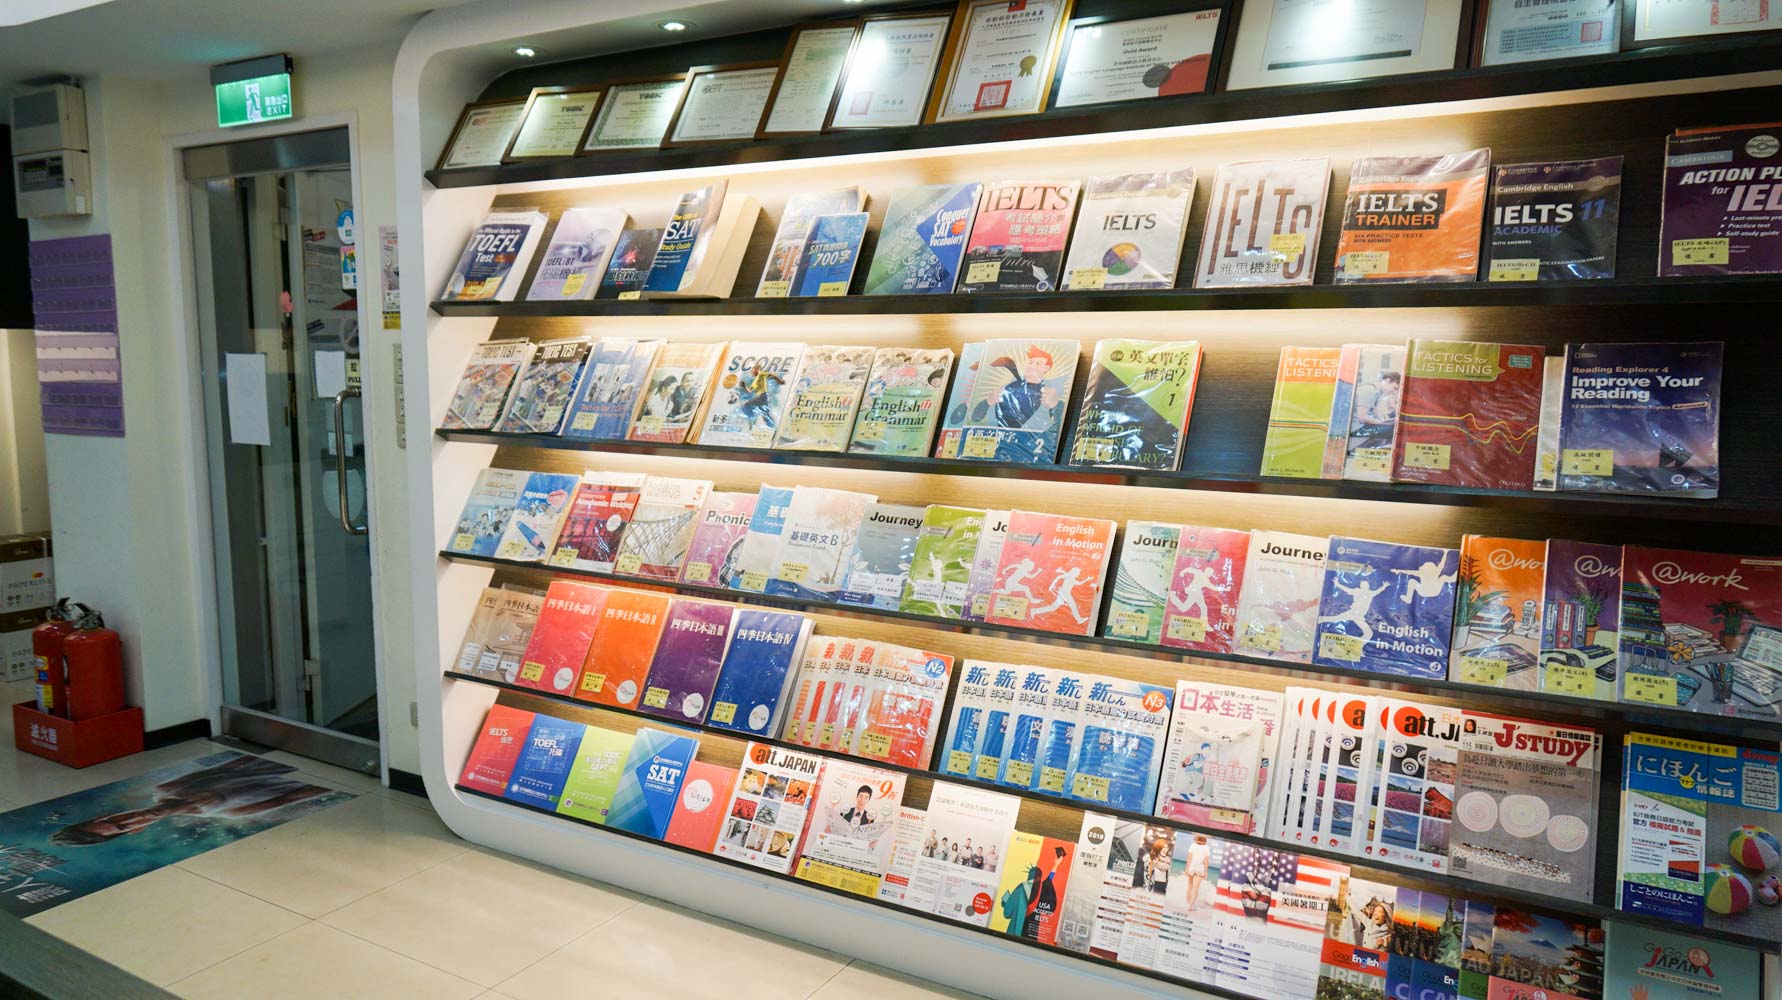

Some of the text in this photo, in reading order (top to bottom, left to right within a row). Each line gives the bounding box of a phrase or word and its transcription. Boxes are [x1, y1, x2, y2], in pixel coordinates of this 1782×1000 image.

[1195, 12, 1218, 20] IELTS
[266, 104, 287, 116] EXIT
[1671, 154, 1725, 164] CAMBRIDGE
[1678, 166, 1782, 186] ACTION PL
[1496, 182, 1574, 194] Cambridge English
[983, 185, 1074, 213] IELTS
[1356, 193, 1438, 212] IELTS
[1711, 184, 1782, 211] for IEL
[936, 208, 970, 223] Conquer
[1355, 214, 1436, 226] TRAINER
[1493, 200, 1606, 225] IELTS 11
[665, 218, 701, 240] SAT
[933, 222, 951, 237] SAT
[1103, 213, 1157, 231] IELTS
[1493, 225, 1563, 237] ACADEMIC
[469, 234, 520, 252] TOEFL
[660, 242, 692, 252] Study Guide
[929, 235, 964, 247] Vocabulary
[475, 252, 494, 263] Test
[812, 250, 851, 266] 700字
[1219, 262, 1280, 276] 雅思機經
[500, 345, 517, 358] TEST
[560, 344, 579, 358] TEST
[1128, 349, 1190, 366] 英文單字
[1413, 351, 1488, 365] TACTICS for
[728, 355, 795, 373] SCORE
[1288, 357, 1338, 368] TACTICS
[1413, 362, 1493, 376] LISTENING
[1143, 367, 1187, 388] 誰怕?
[1284, 367, 1338, 378] LISTENI
[1572, 366, 1613, 375] Reading
[1615, 366, 1660, 375] Explorer
[1571, 375, 1704, 390] Improve Your
[796, 395, 843, 408] English
[1167, 393, 1176, 406] 1
[1571, 387, 1651, 403] Reading
[871, 397, 921, 414] English
[789, 407, 849, 421] Grammar
[864, 411, 928, 426] Grammar
[1033, 438, 1045, 454] 2
[705, 510, 751, 526] Phonic
[869, 511, 924, 529] Journey
[1055, 523, 1096, 536] English
[1052, 537, 1104, 550] in Motion
[1133, 534, 1178, 549] Journ
[1487, 549, 1544, 570] @wo
[1652, 561, 1750, 591] @work
[1378, 621, 1429, 639] English
[1376, 637, 1444, 658] in Motion
[926, 662, 944, 675] N2
[1430, 661, 1441, 671] 4
[965, 665, 989, 687] 新し
[993, 667, 1016, 690] 新し
[1022, 671, 1049, 693] 新し
[1056, 676, 1082, 699] 新し
[1143, 694, 1164, 708] N3
[1179, 688, 1254, 721] 日本生活
[1737, 707, 1777, 718] Richmond
[489, 727, 509, 737] IELTS
[1403, 714, 1461, 742] att.J
[533, 738, 558, 749] TOEFL
[1493, 722, 1592, 767] J'STUDY
[755, 748, 818, 775] att.JAPAN
[647, 764, 681, 786] SAT
[1636, 753, 1737, 787] にほんご
[900, 812, 920, 822] British
[1632, 818, 1647, 828] 官方
[1038, 901, 1051, 910] USA
[1351, 953, 1380, 969] English
[1329, 964, 1382, 991] IRELA
